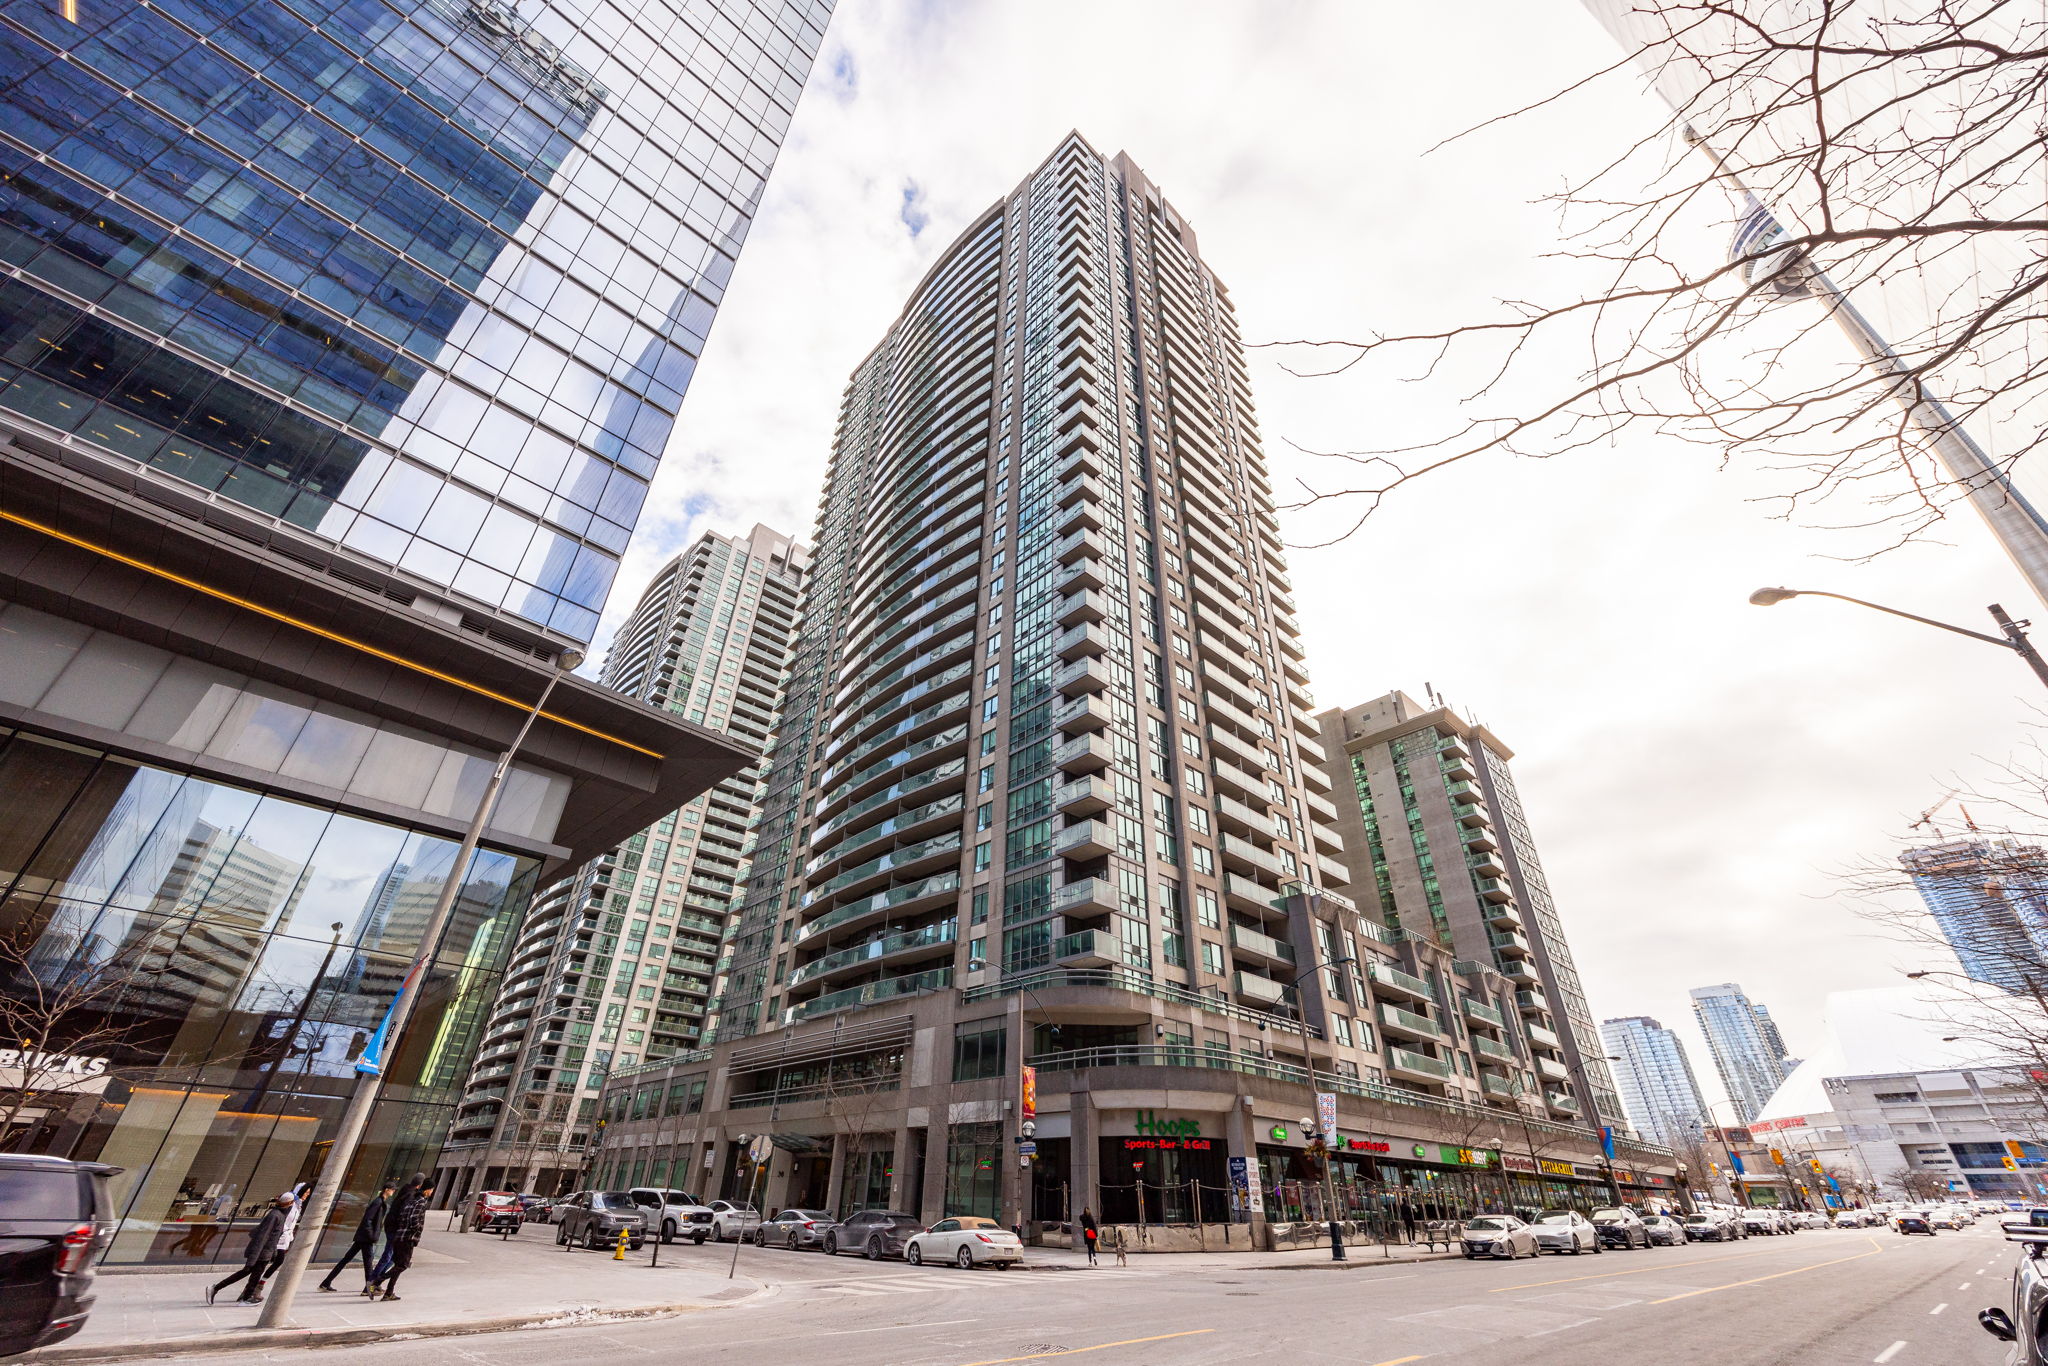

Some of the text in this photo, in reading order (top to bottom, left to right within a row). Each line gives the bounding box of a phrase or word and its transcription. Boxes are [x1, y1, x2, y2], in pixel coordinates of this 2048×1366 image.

[1134, 1110, 1200, 1144] Hoops
[1124, 1139, 1210, 1150] Sports Bar & Grill
